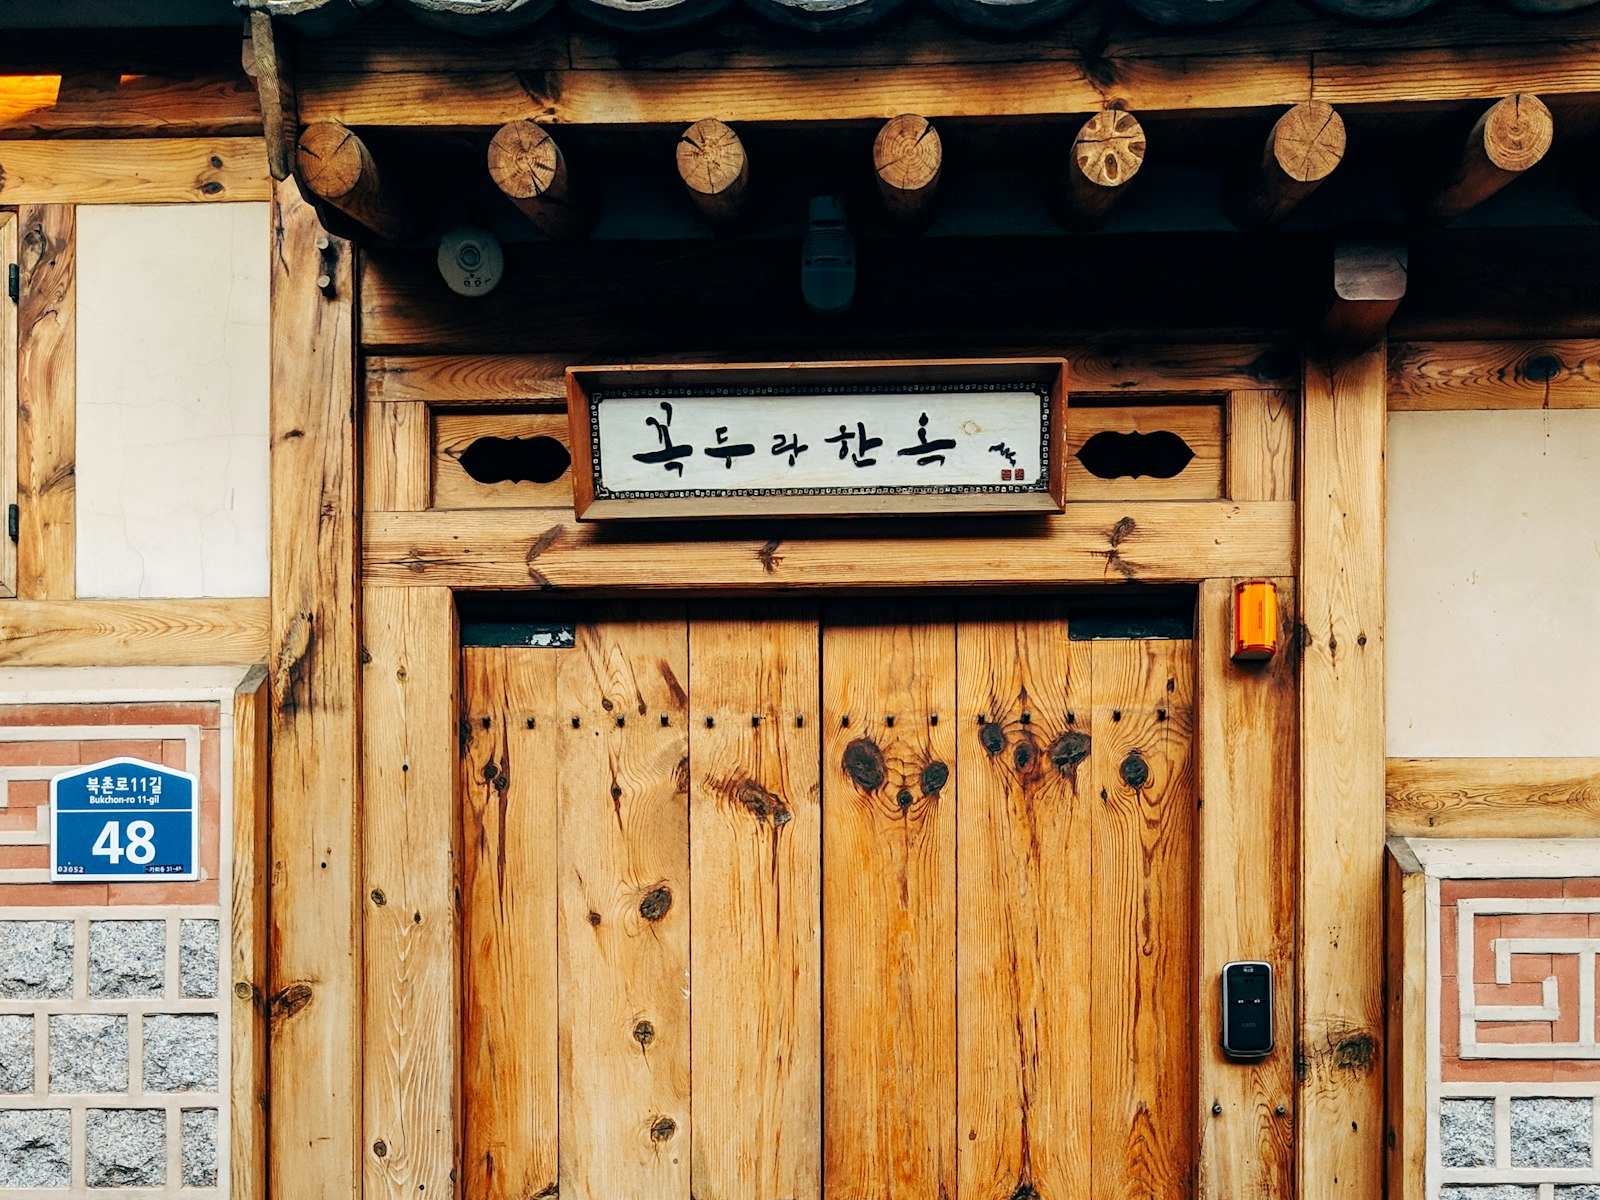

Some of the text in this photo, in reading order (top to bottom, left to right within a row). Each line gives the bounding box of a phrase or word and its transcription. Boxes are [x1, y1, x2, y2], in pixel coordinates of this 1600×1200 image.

[86, 776, 162, 794] 북촌로11길
[89, 795, 160, 805] Bukchon-ro 11-gil
[92, 820, 156, 865] 48
